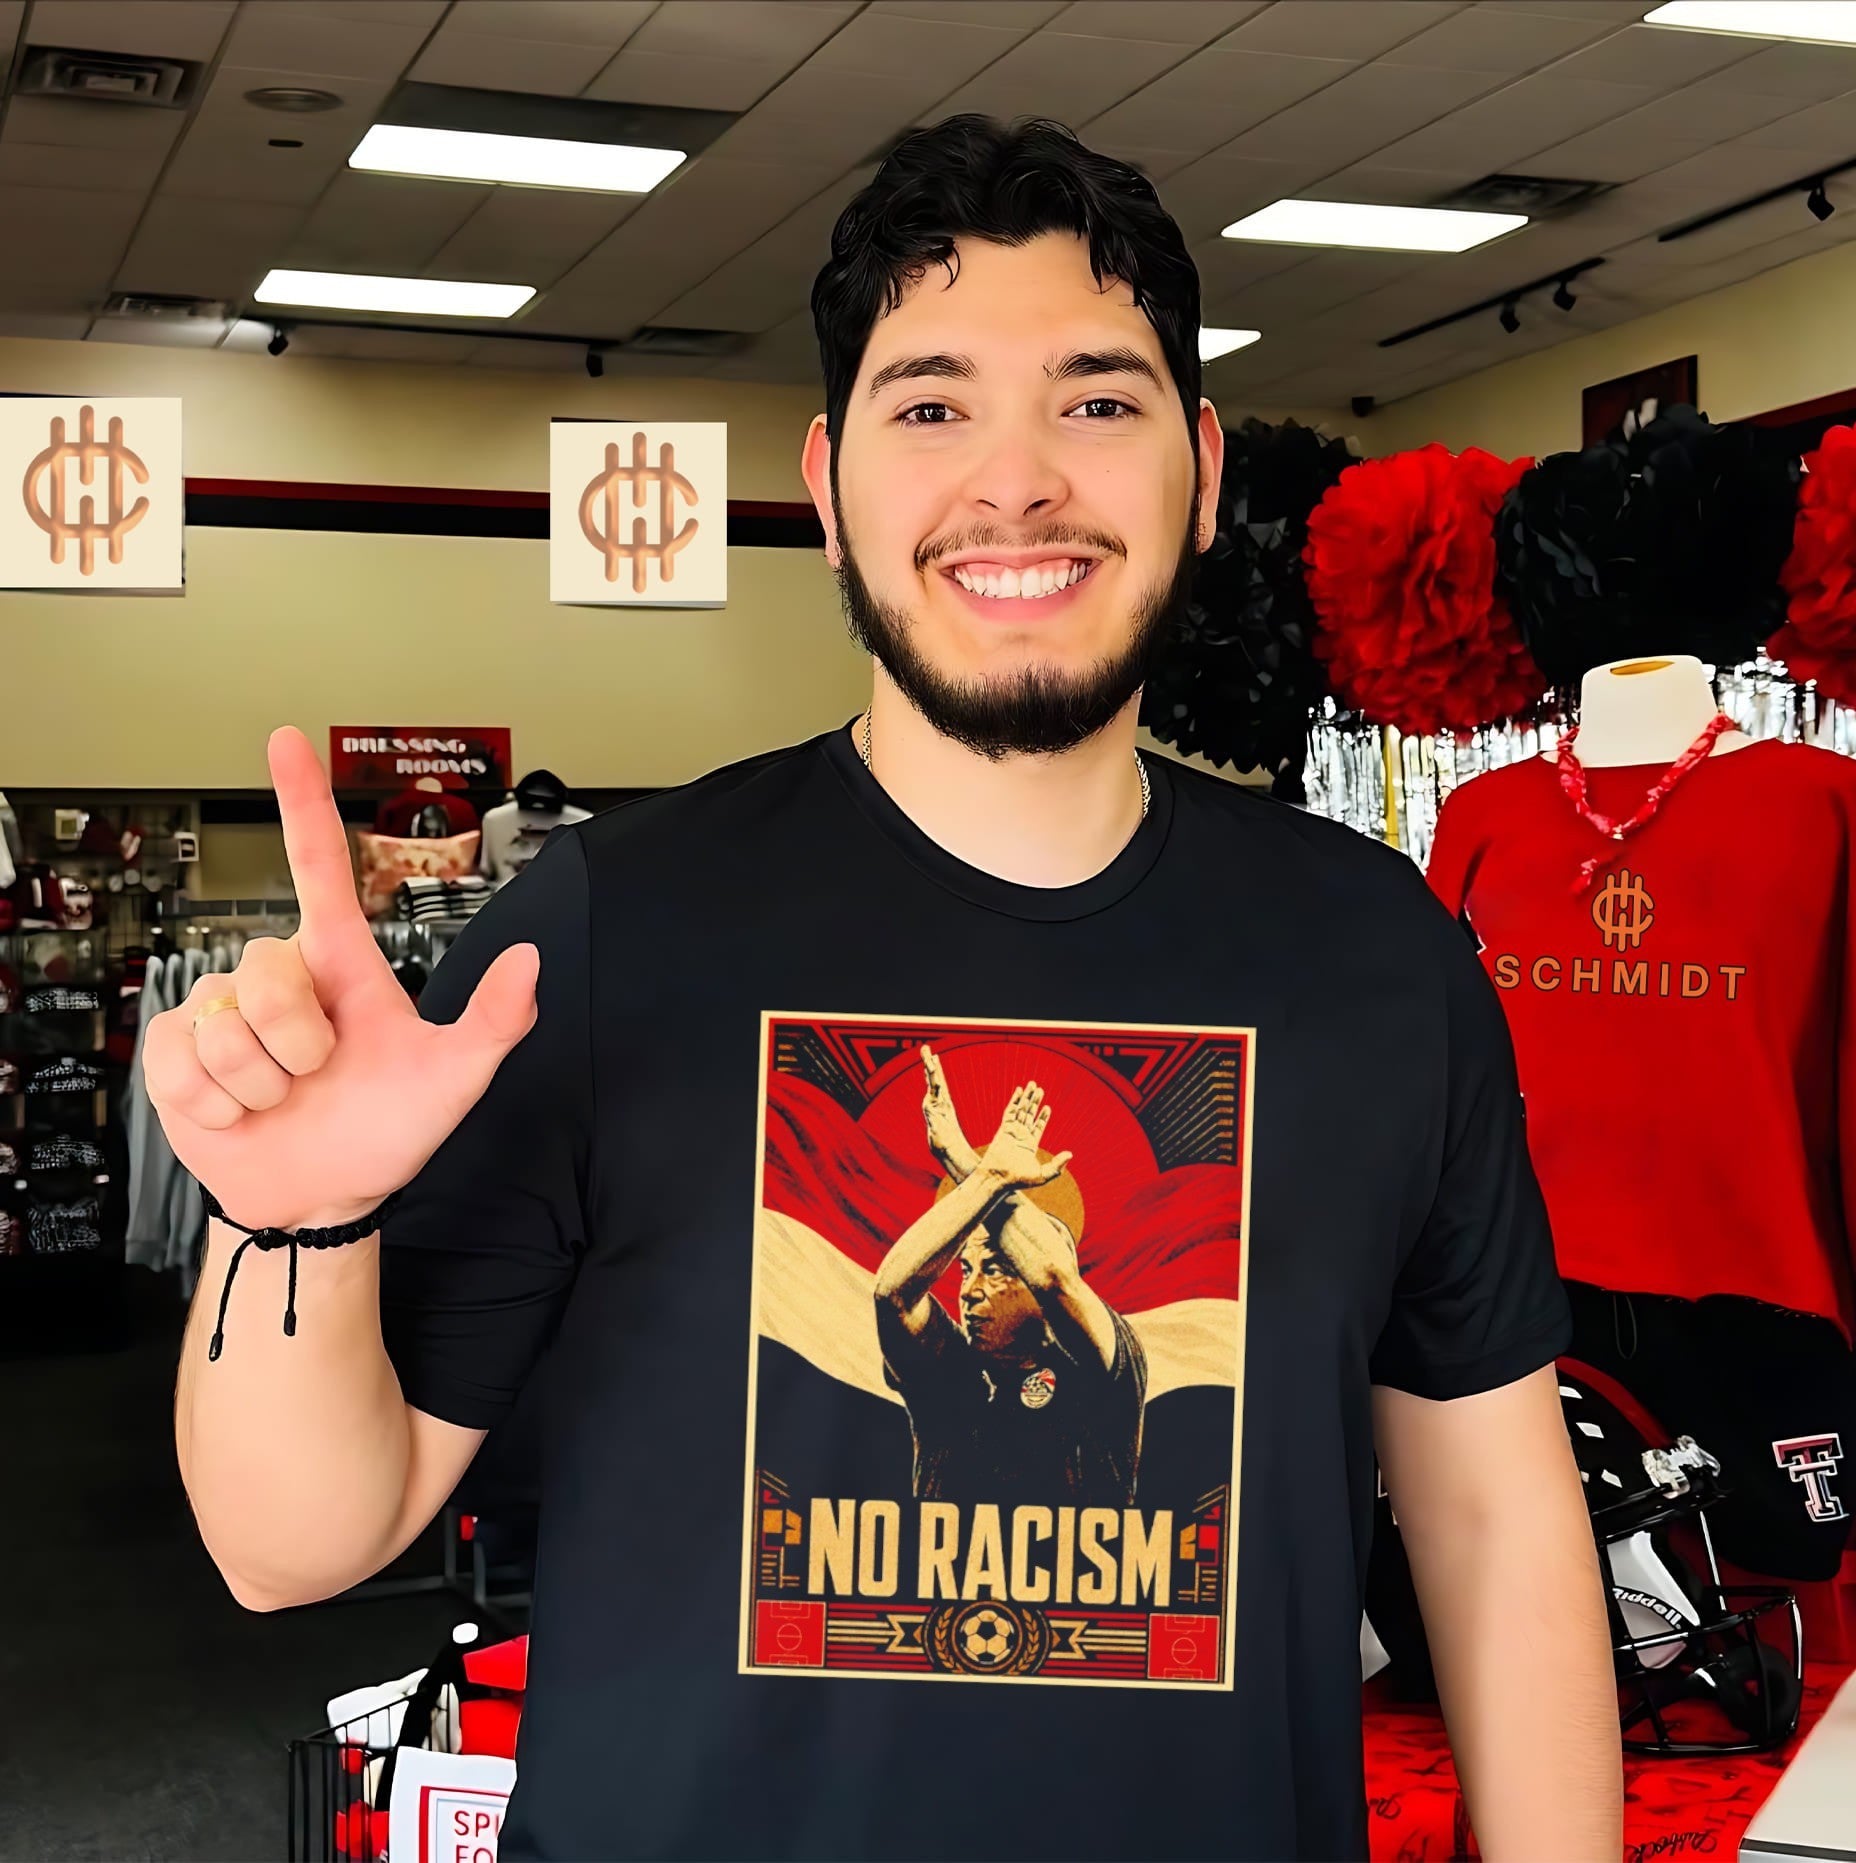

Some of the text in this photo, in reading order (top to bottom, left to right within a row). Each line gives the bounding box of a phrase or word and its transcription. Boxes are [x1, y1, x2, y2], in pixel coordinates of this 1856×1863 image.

[342, 736, 467, 754] DRESSING
[396, 758, 488, 775] ROOMS
[1494, 953, 1747, 1000] SCHMIDT
[808, 1498, 1174, 1607] NO RACISM
